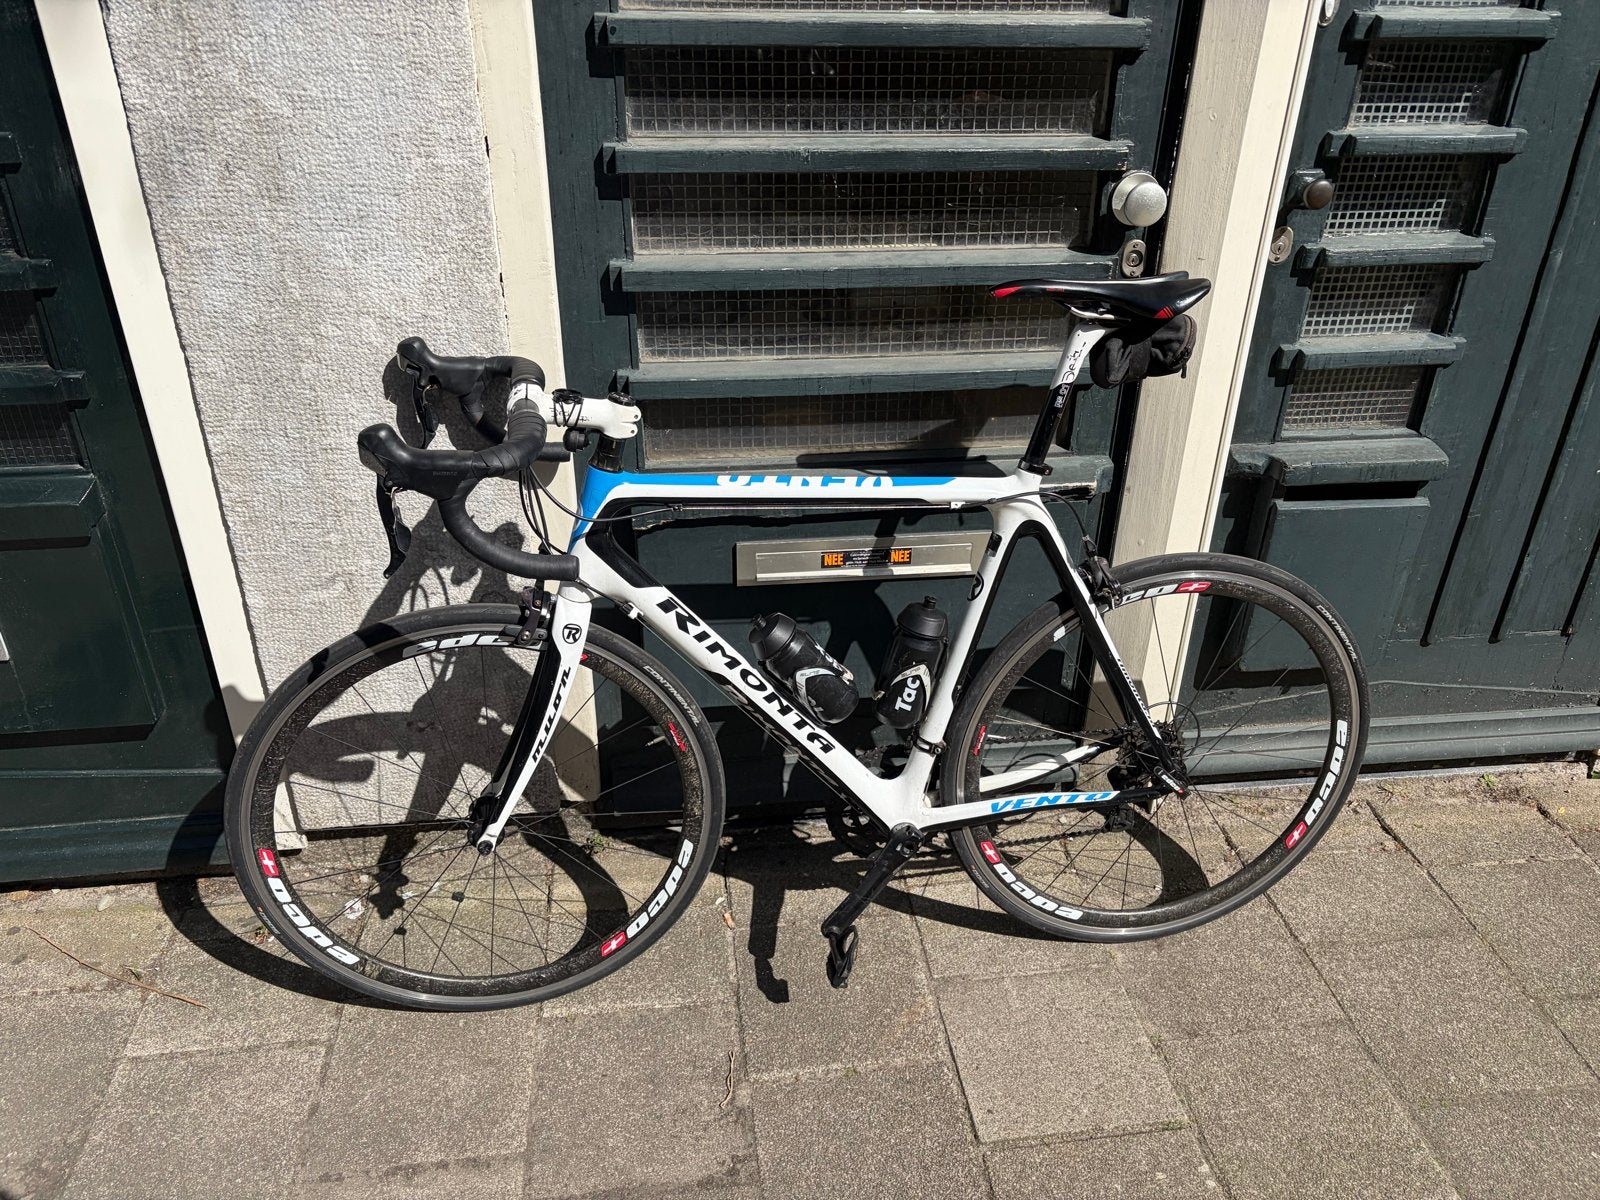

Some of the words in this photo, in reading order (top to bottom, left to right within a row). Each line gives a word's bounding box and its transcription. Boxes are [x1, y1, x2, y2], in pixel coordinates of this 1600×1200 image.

[824, 553, 844, 566] NEE
[890, 549, 910, 562] NEE
[563, 624, 582, 643] R
[1316, 604, 1358, 662] CONTINENTAL
[643, 665, 700, 727] CONTINENTAL
[656, 596, 836, 754] RIMONTA
[895, 677, 921, 712] Tac
[1304, 719, 1348, 826] edco
[991, 792, 1112, 813] VENTO
[626, 839, 694, 939] edco
[993, 863, 1084, 920] edco
[267, 877, 360, 965] edco
